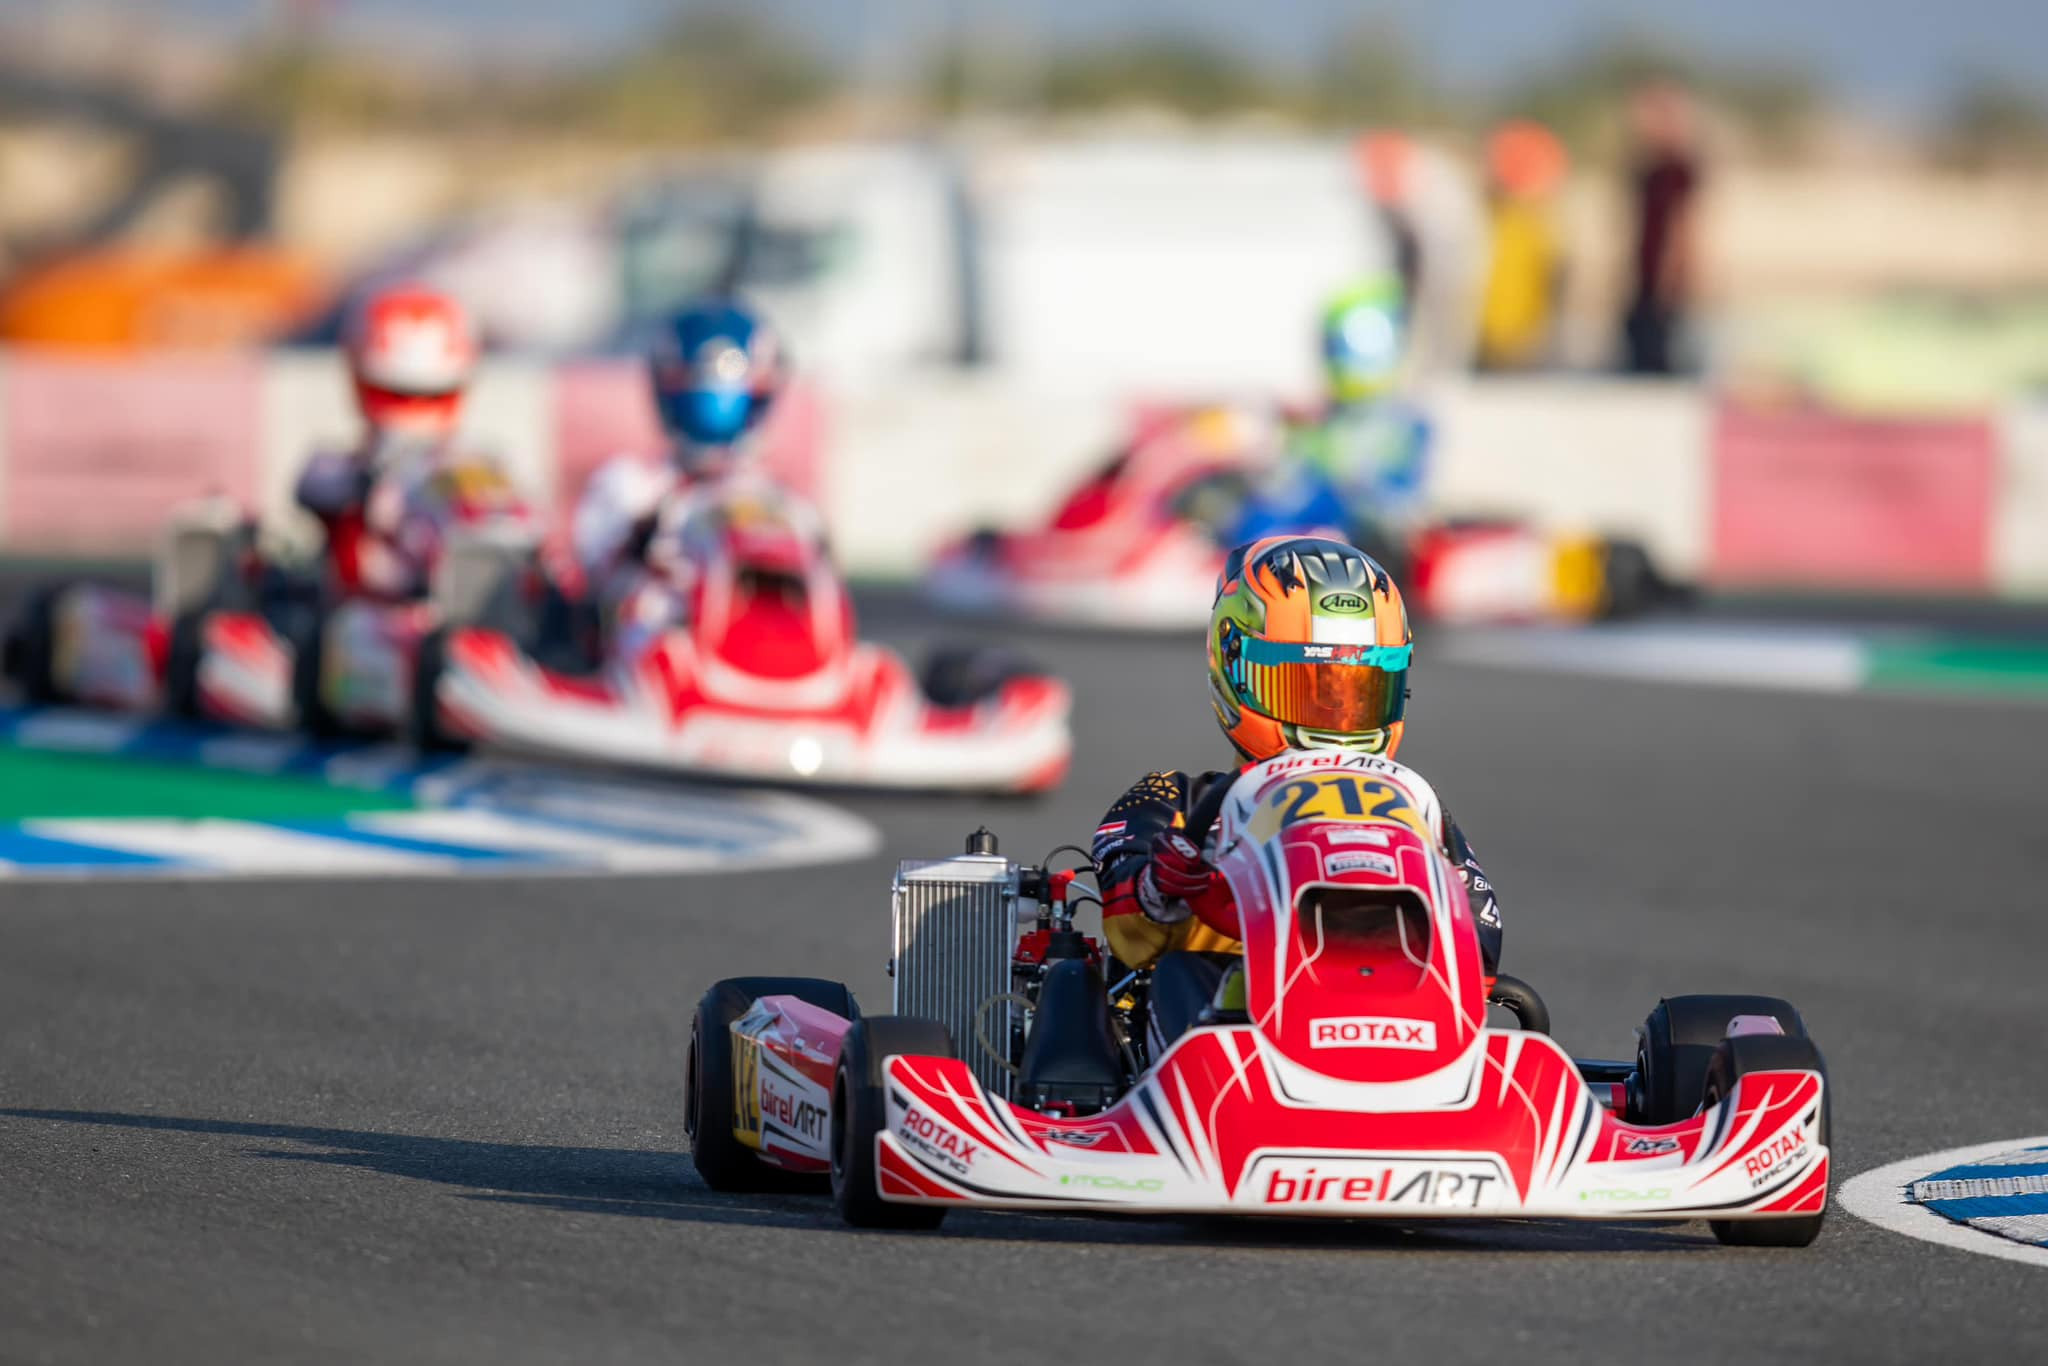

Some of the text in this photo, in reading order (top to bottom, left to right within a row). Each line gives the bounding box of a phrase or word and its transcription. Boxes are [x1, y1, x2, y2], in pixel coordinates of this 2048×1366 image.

[1326, 595, 1362, 608] Arai
[1272, 778, 1411, 828] 212
[1318, 1023, 1426, 1043] ROTAX
[904, 1108, 976, 1164] ROTAX
[1745, 1126, 1806, 1178] ROTAX
